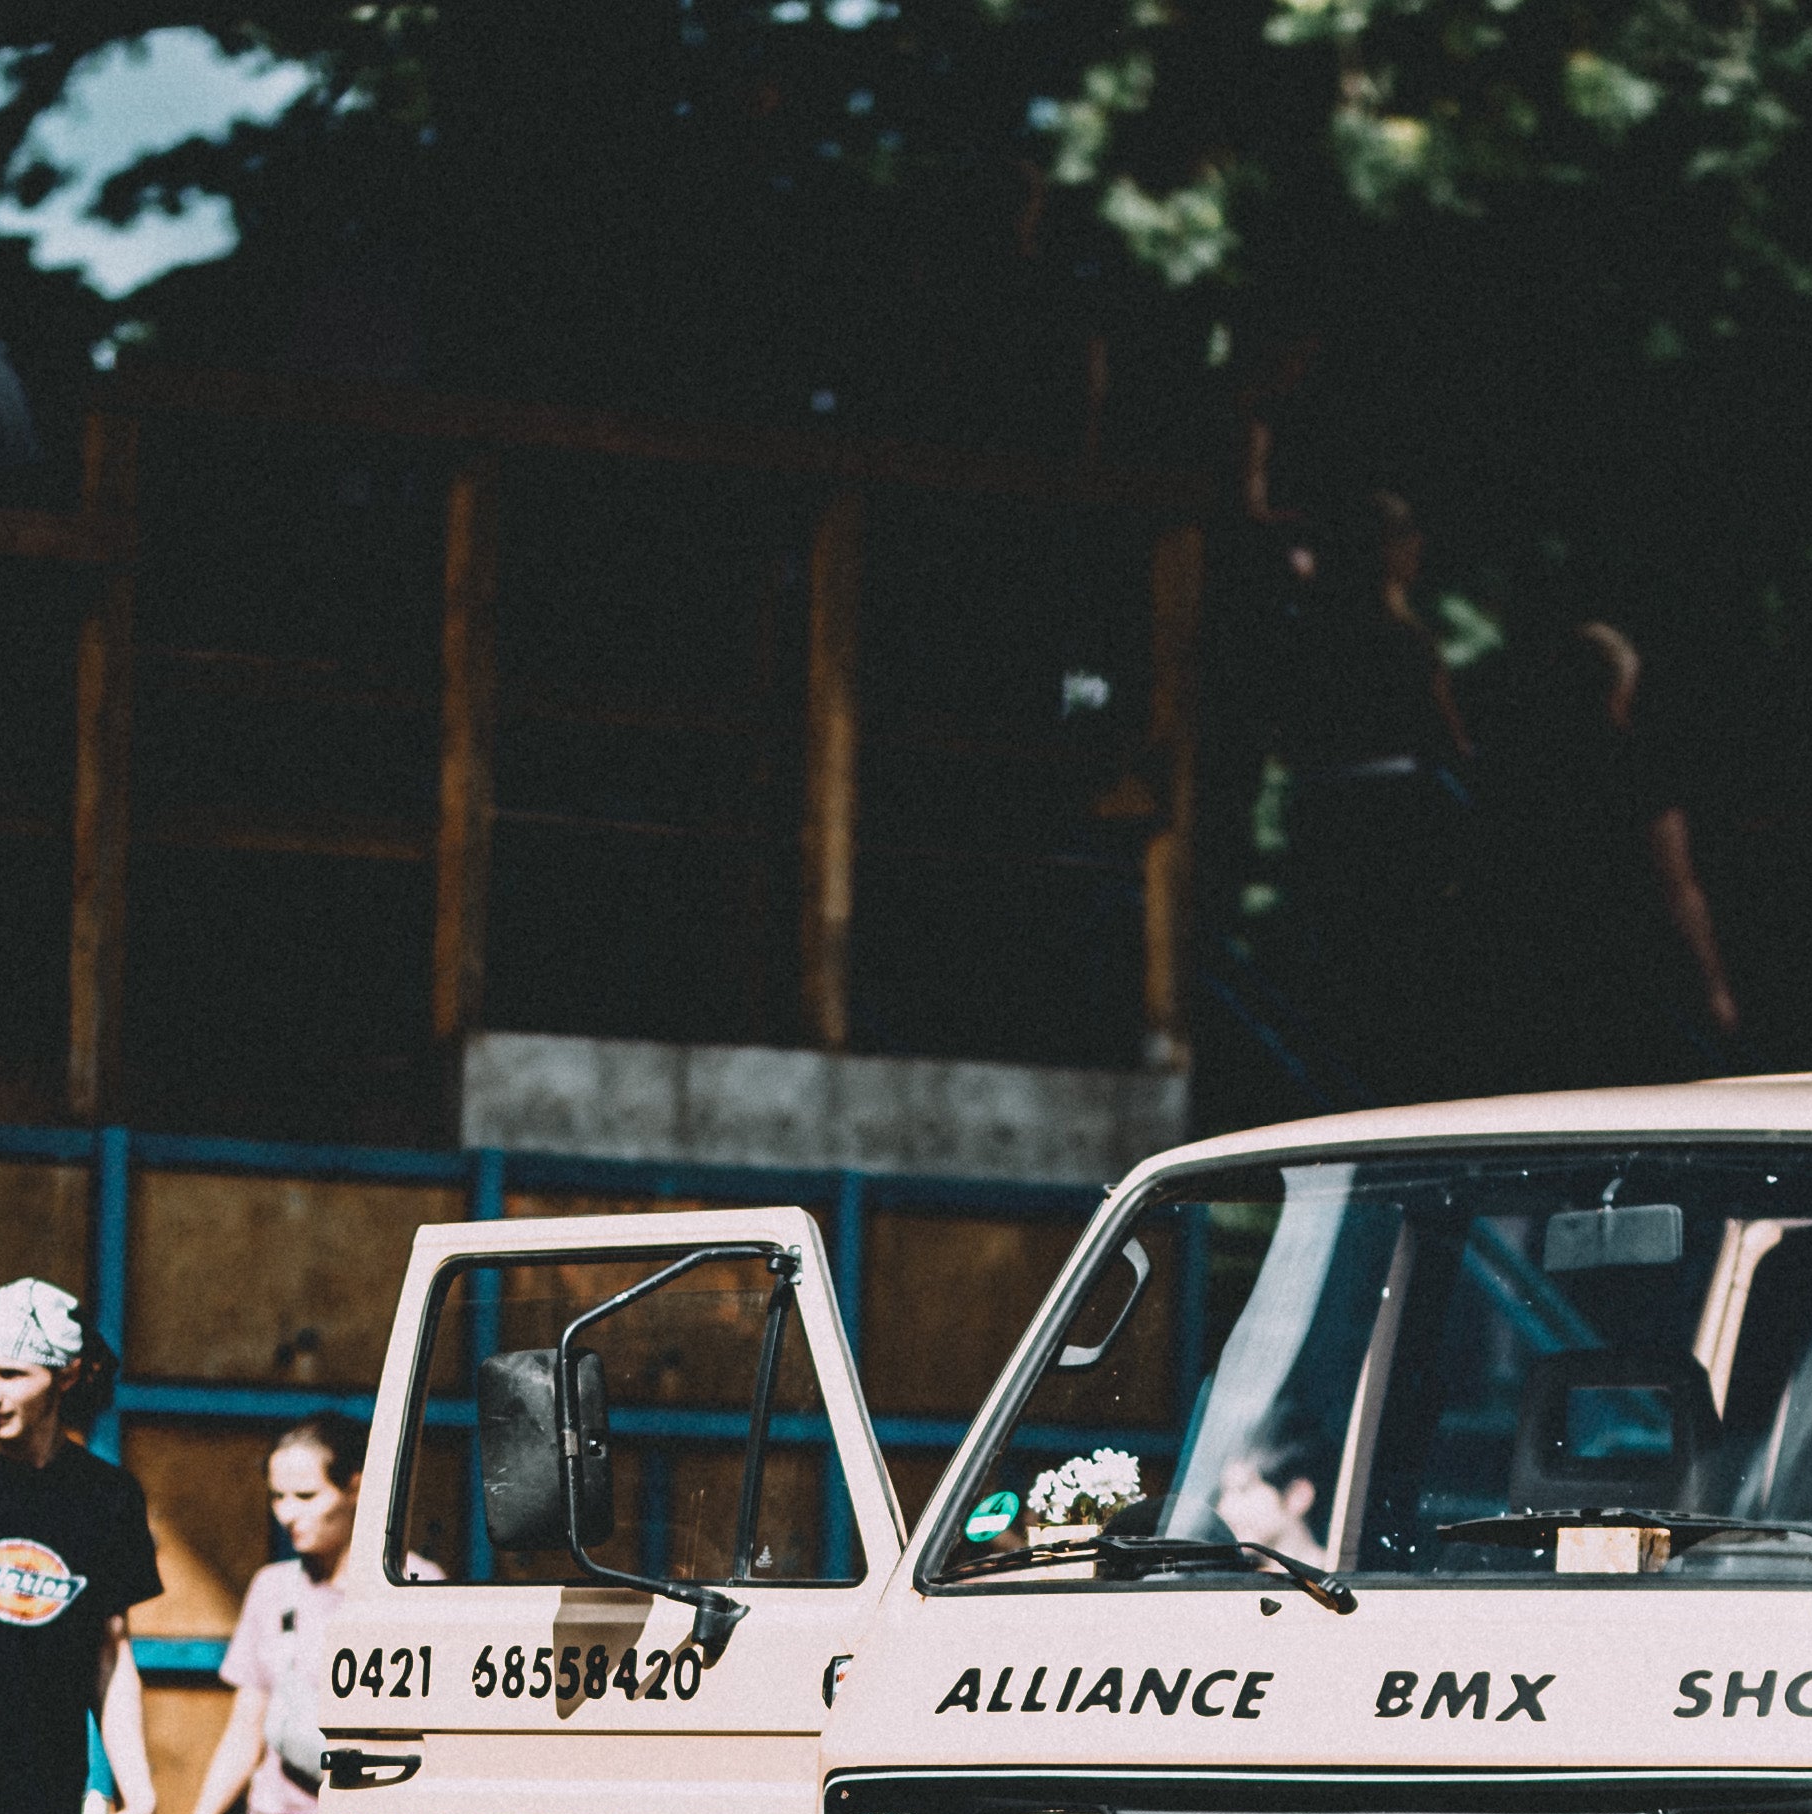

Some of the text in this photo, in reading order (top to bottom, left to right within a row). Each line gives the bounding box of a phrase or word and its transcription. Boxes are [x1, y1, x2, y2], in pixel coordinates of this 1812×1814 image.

[988, 1493, 1007, 1516] 4
[331, 1644, 703, 1702] 0421 68558420
[934, 1666, 1275, 1720] ALLIANCE
[1374, 1670, 1557, 1722] BMX
